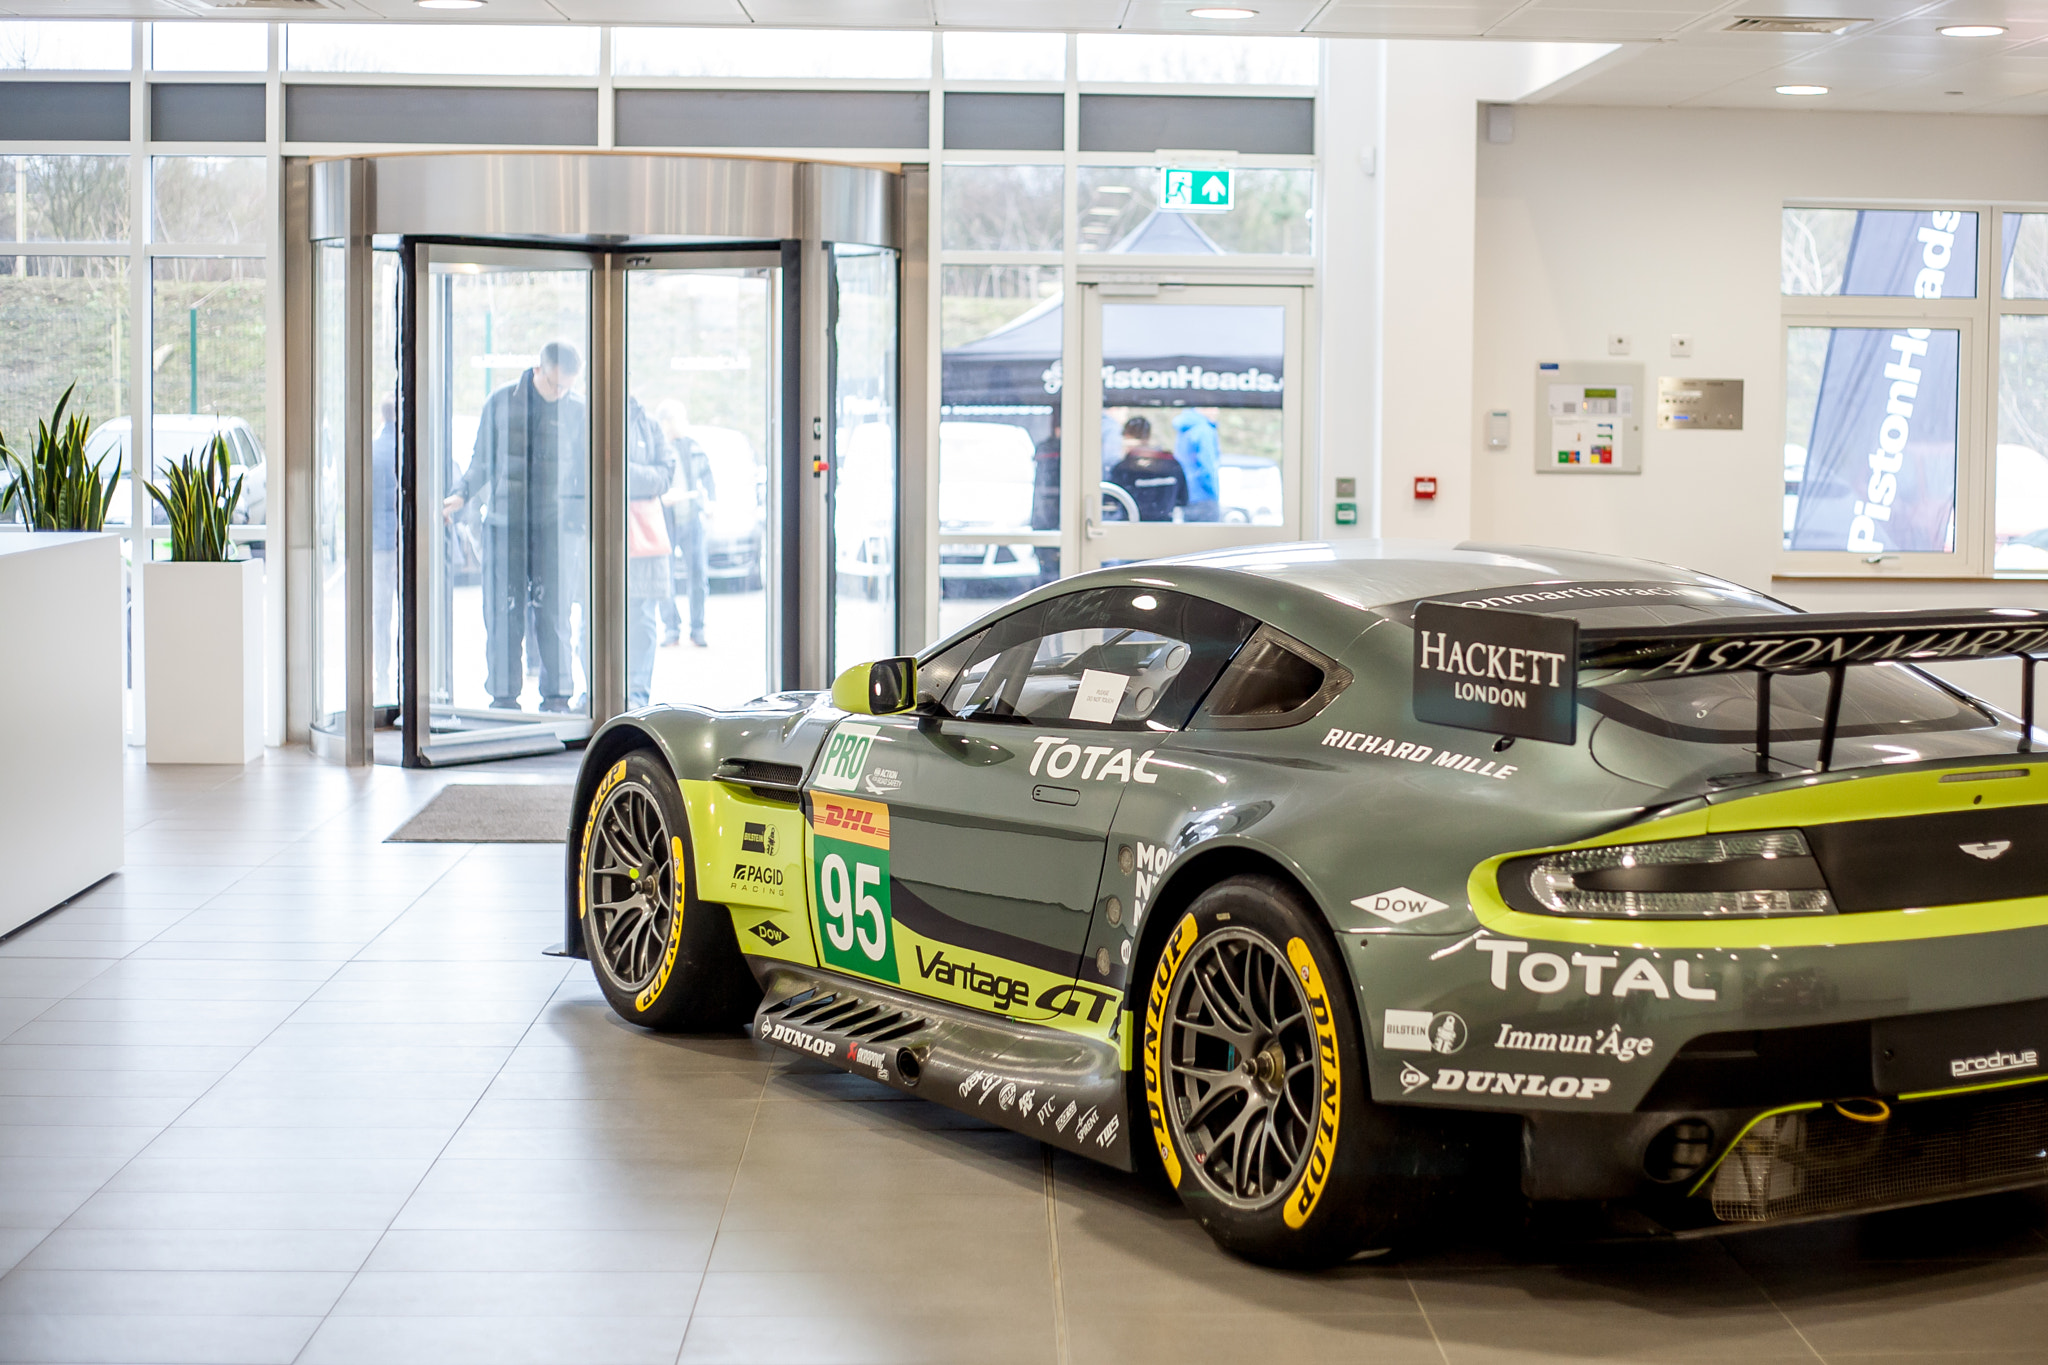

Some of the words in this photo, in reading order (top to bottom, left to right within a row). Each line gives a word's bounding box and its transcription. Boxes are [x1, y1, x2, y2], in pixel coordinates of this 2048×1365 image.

[1420, 630, 1566, 687] HACKETT
[1642, 636, 1874, 677] ASTON
[1454, 681, 1527, 709] LONDON
[822, 733, 870, 780] PRO
[1029, 736, 1159, 784] TOTAL
[1321, 728, 1433, 763] RICHARD
[1431, 750, 1519, 780] MILLE
[825, 804, 876, 834] DHL
[730, 882, 784, 896] RACING
[747, 865, 784, 886] PAGID
[821, 853, 887, 961] 95
[915, 945, 1029, 1010] Vantage
[1475, 939, 1716, 1001] TOTAL
[771, 1024, 836, 1057] DUNLOP
[1145, 922, 1183, 1134] DUNLOP
[1386, 1023, 1426, 1037] BILSTEIN
[1432, 1069, 1611, 1099] DUNLOP
[1951, 1050, 2037, 1077] prodrive
[1037, 1094, 1055, 1126] PTC
[1298, 993, 1337, 1216] DUNLOP
